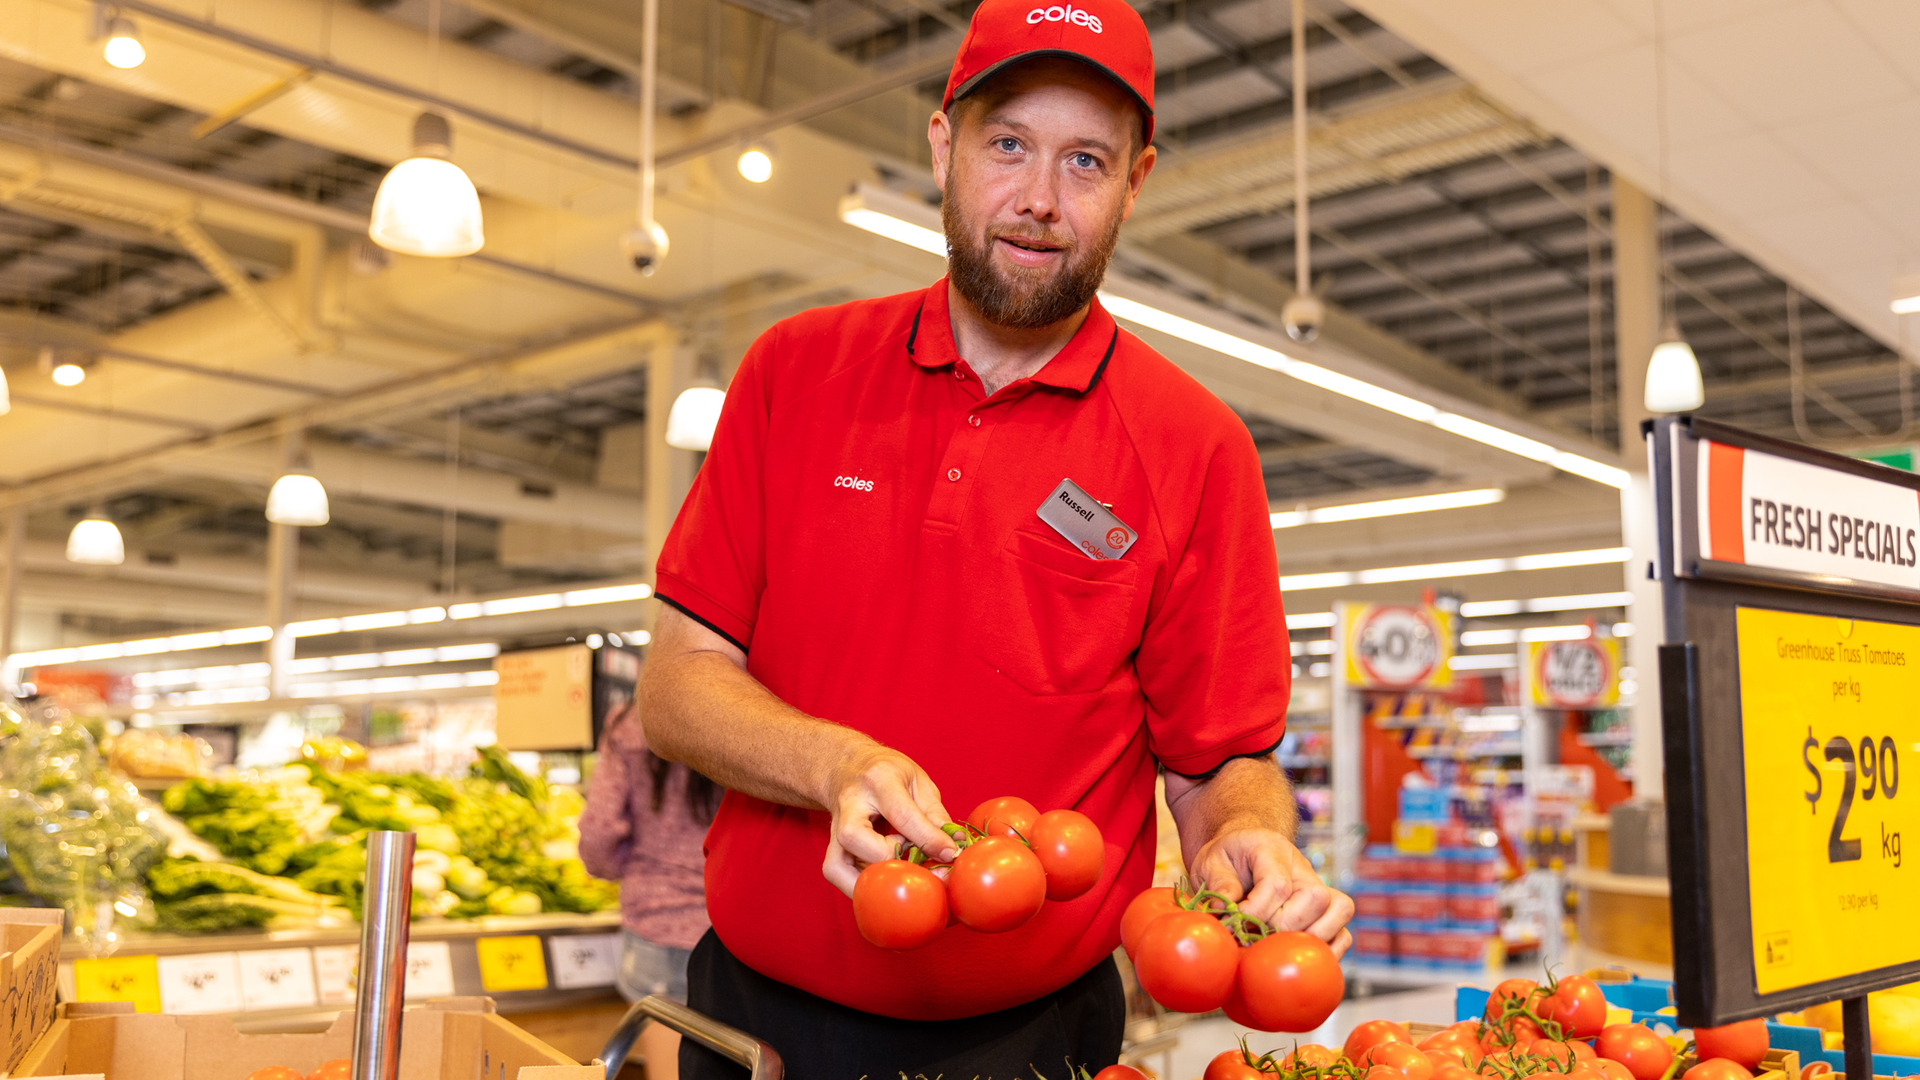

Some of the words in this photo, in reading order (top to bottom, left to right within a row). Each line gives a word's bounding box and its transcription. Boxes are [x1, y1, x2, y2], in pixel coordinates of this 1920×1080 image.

[1026, 3, 1103, 34] coles
[834, 475, 875, 492] coles
[1059, 491, 1095, 522] Russell
[1110, 532, 1124, 545] 20
[1750, 498, 1822, 552] FRESH
[1828, 513, 1917, 567] SPECIALS
[1777, 637, 1835, 661] Greenhouse
[1836, 642, 1861, 663] Truss
[1862, 644, 1906, 666] Tomatoes
[1832, 681, 1847, 702] per
[1849, 675, 1861, 703] kg
[1882, 821, 1901, 868] kg
[1857, 895, 1868, 912] per
[1868, 890, 1879, 911] kg
